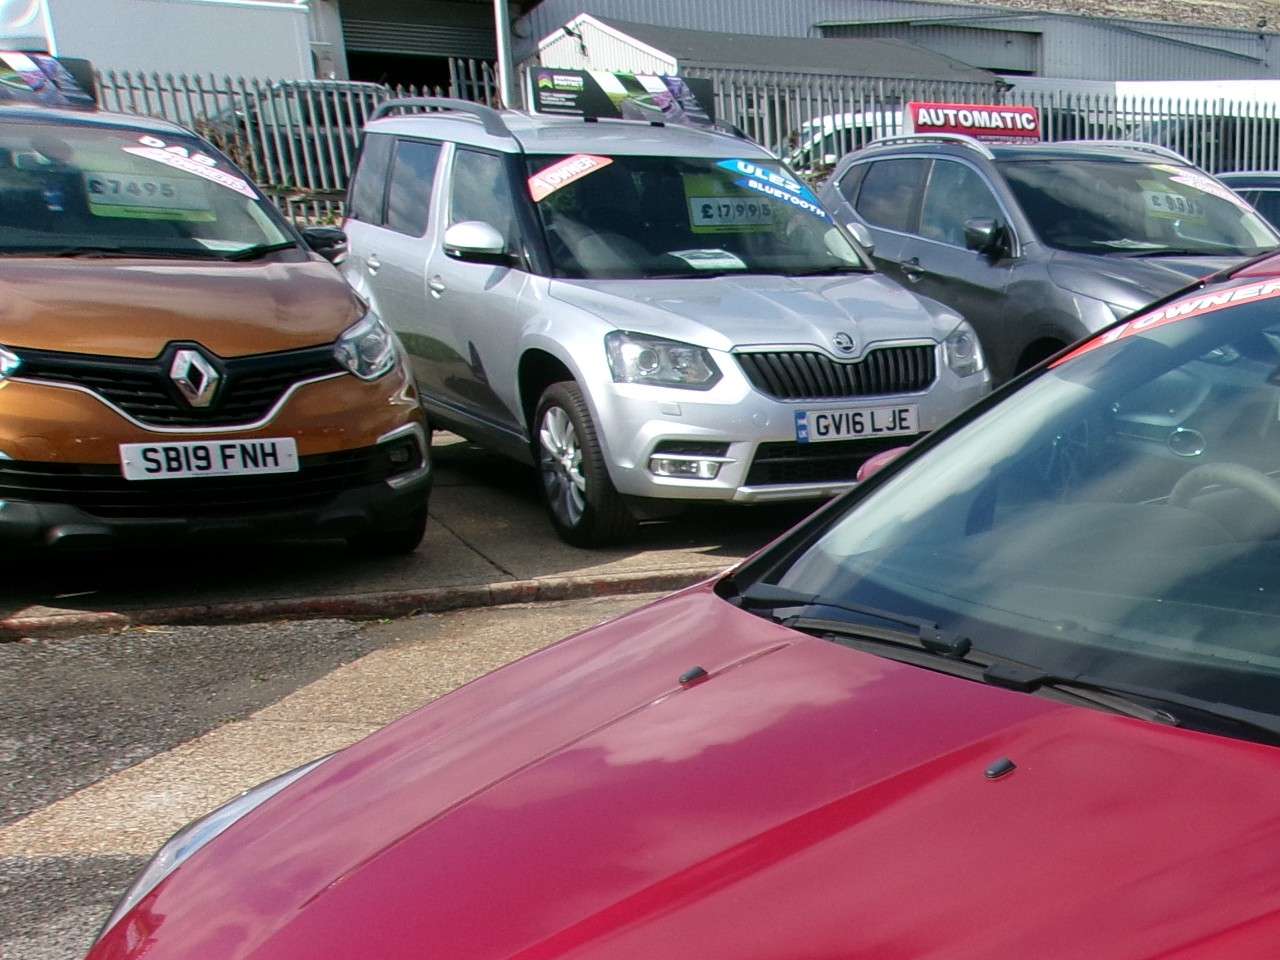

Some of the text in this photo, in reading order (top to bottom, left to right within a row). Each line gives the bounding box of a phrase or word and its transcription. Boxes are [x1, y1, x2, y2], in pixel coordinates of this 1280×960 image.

[917, 107, 1036, 130] AUTOMATIC
[138, 135, 218, 167] DAB
[735, 159, 802, 194] ULEZ
[747, 178, 826, 218] BLUETOOTH
[816, 408, 911, 436] GV16 LJE
[141, 442, 279, 474] SB19 FNH
